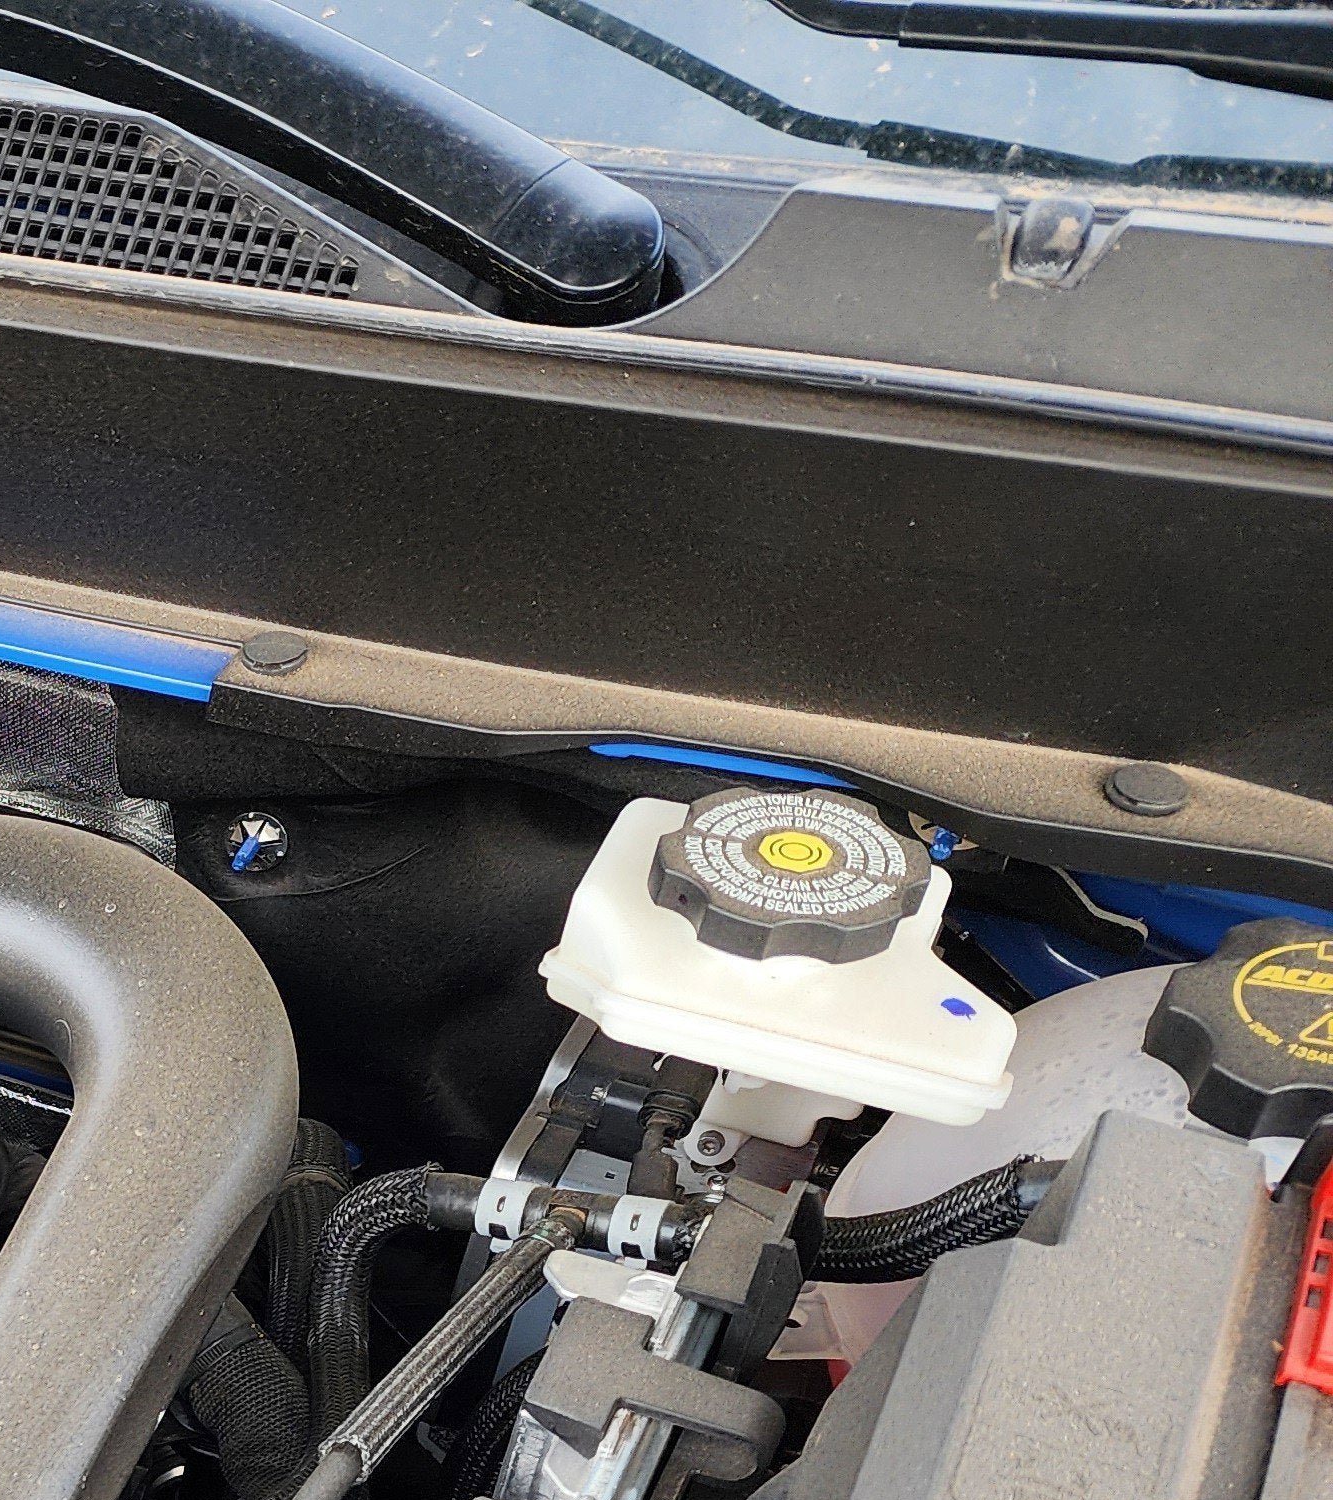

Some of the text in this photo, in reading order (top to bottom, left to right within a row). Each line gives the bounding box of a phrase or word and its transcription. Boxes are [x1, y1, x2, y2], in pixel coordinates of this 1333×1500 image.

[805, 797, 822, 810] LE
[763, 875, 810, 891] CLEAN
[812, 871, 857, 891] FILLER
[713, 879, 754, 903] FROM
[751, 895, 764, 908] A
[764, 898, 822, 915] SEALED
